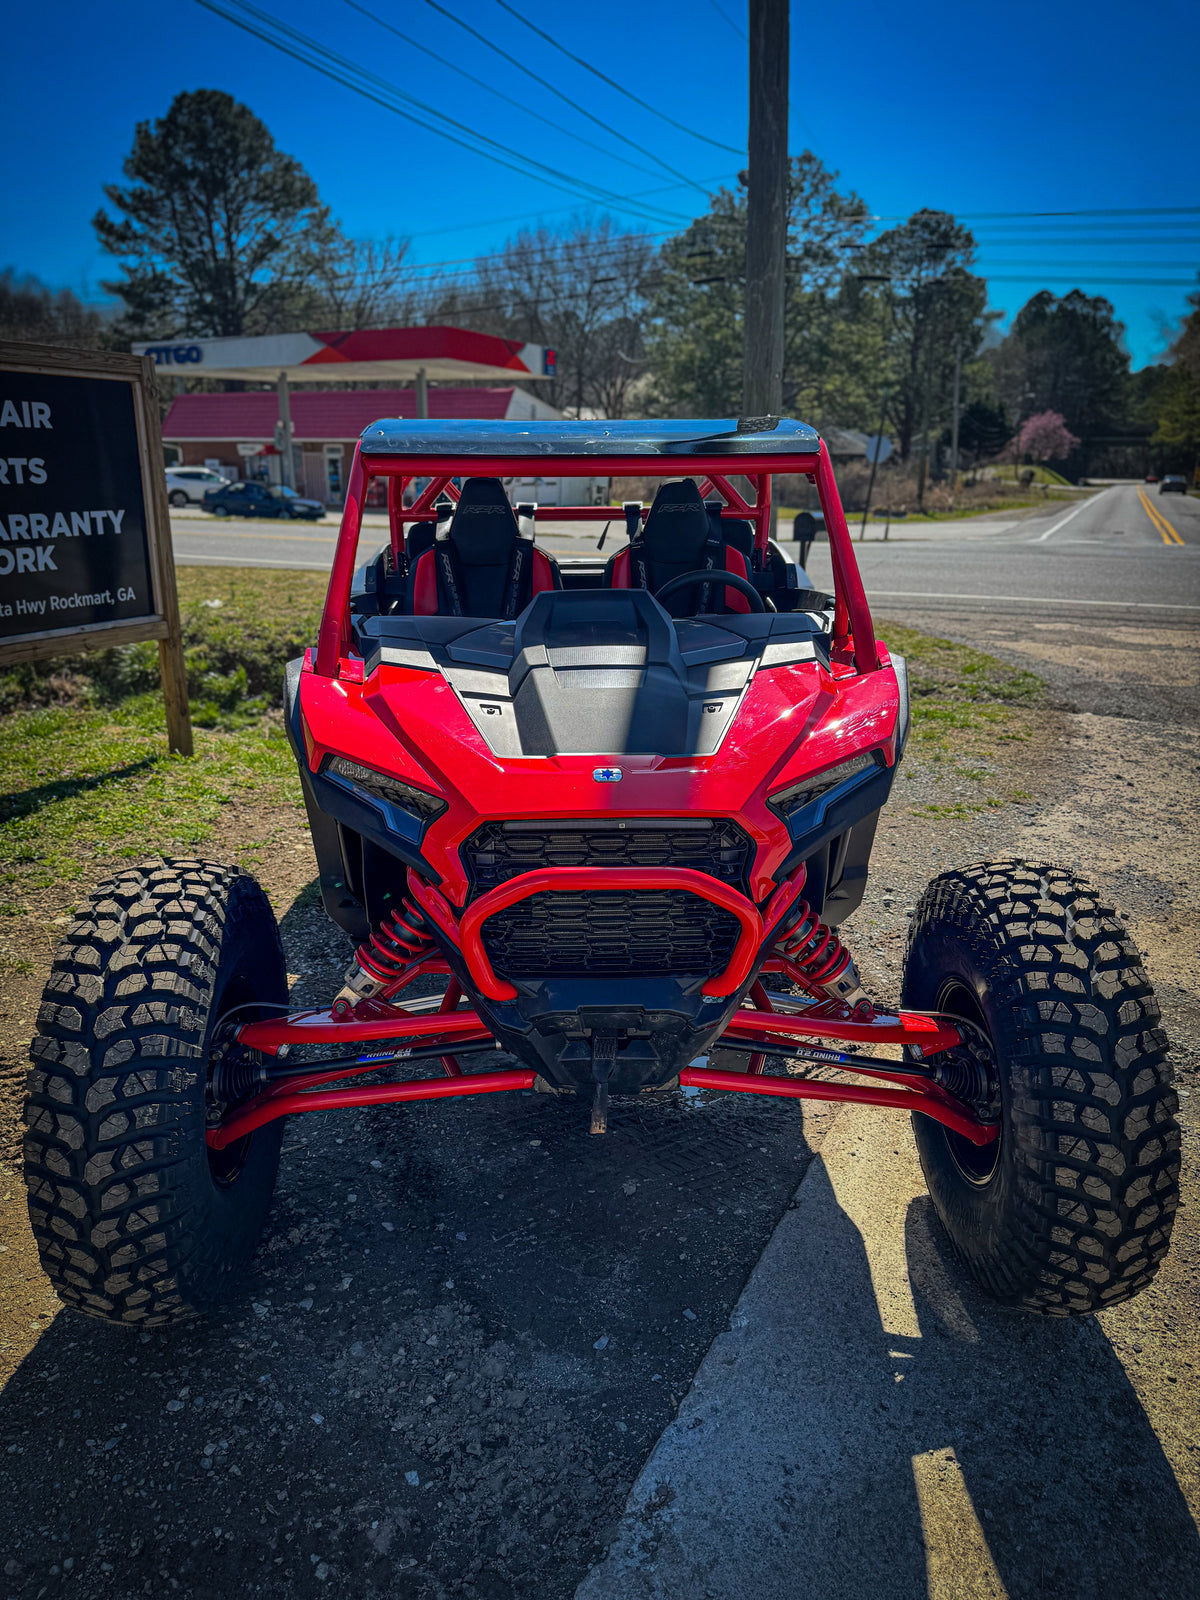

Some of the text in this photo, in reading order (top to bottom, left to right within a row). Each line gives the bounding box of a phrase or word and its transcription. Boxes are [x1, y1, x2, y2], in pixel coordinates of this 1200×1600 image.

[16, 599, 46, 615] Hwy
[50, 590, 115, 610] Rockmart,
[117, 587, 136, 602] GA
[812, 1051, 841, 1061] RHINO
